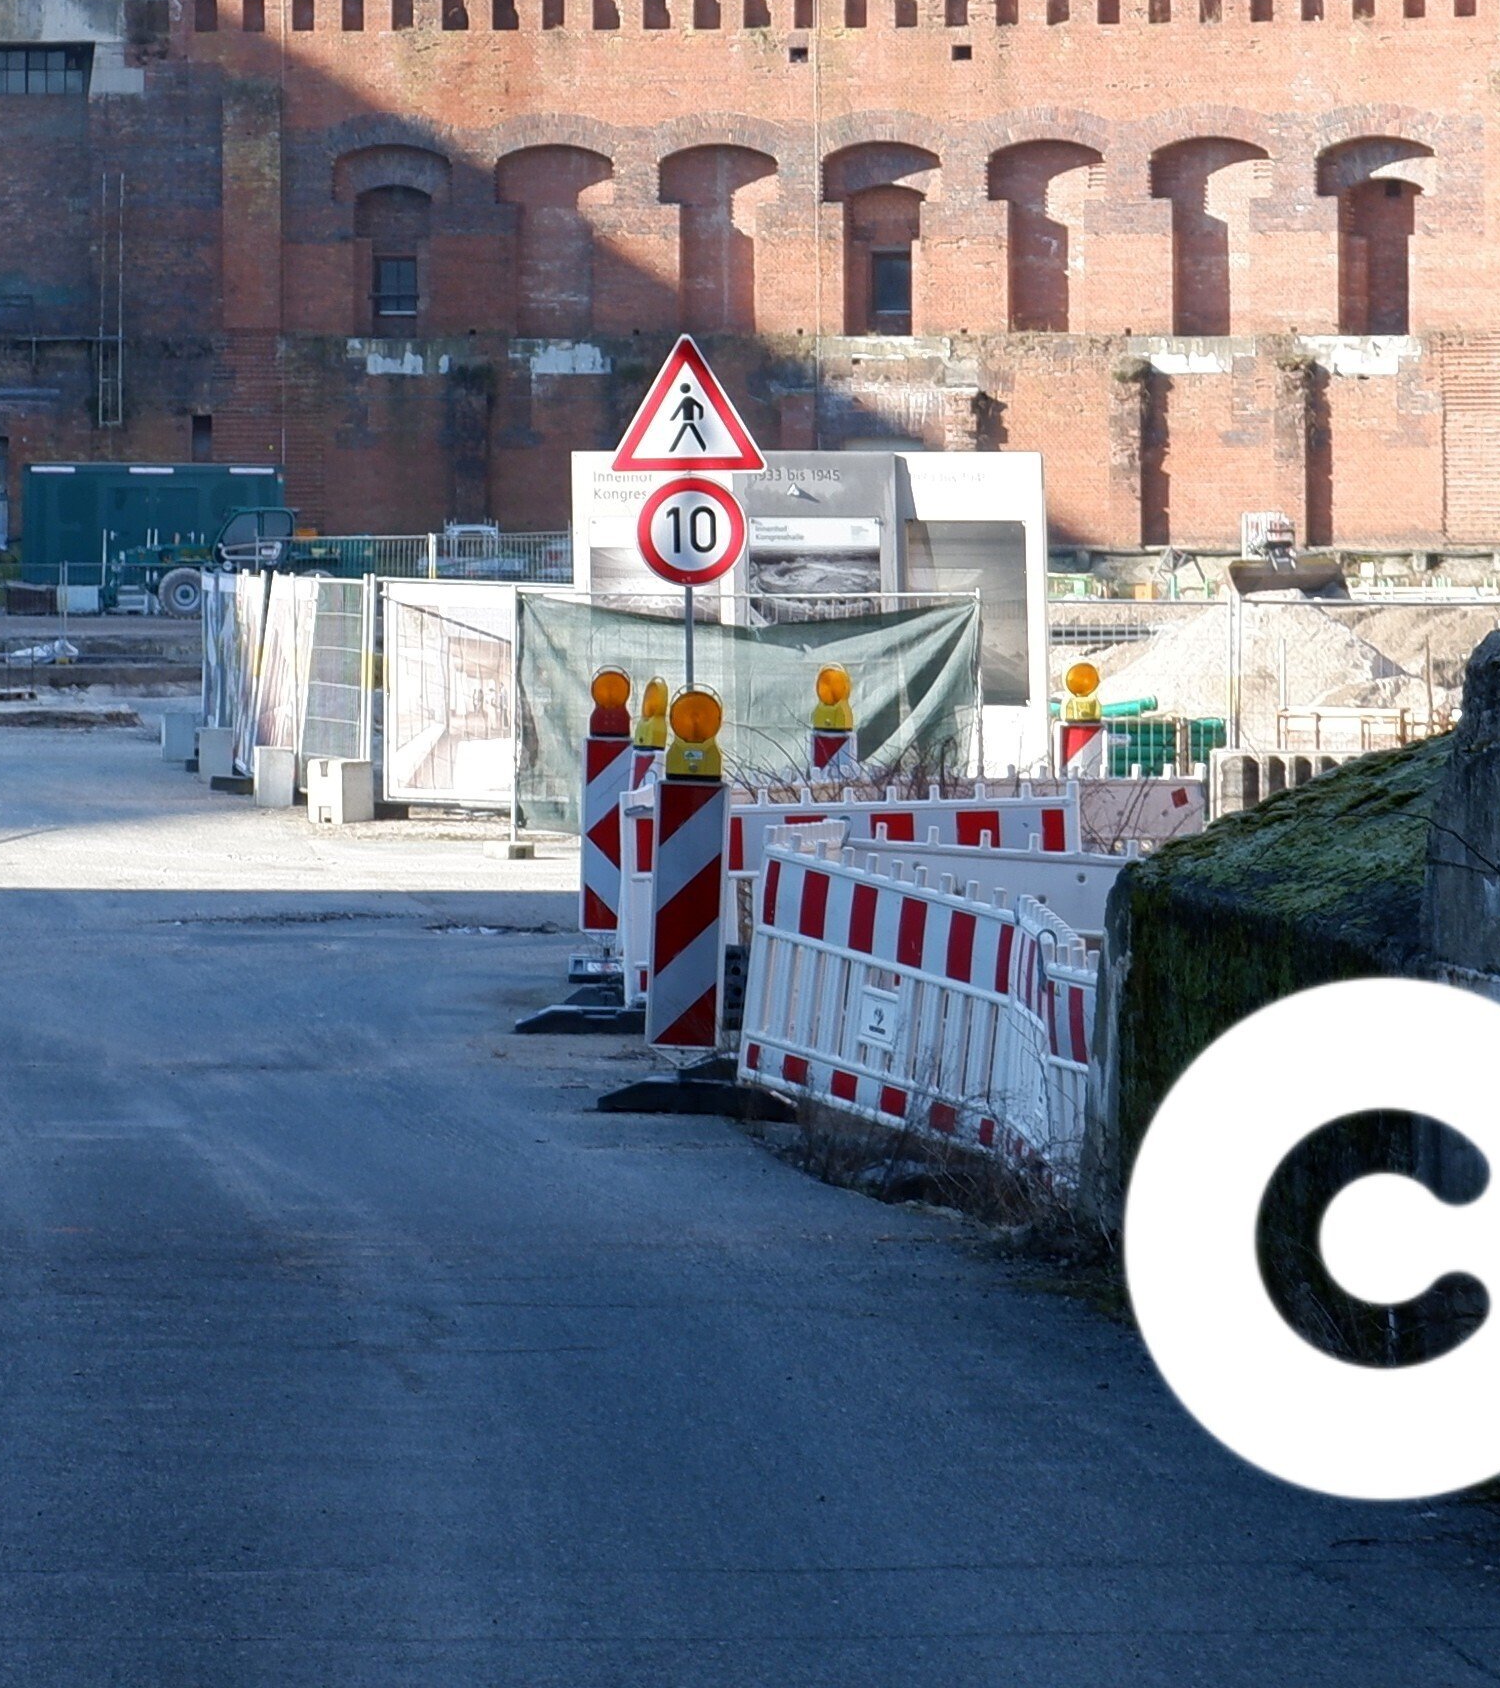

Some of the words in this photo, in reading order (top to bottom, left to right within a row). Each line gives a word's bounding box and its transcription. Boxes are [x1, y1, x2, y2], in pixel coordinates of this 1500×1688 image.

[786, 469, 806, 482] bis
[811, 469, 840, 482] 1945
[593, 489, 647, 501] Kongres
[665, 505, 716, 554] 10
